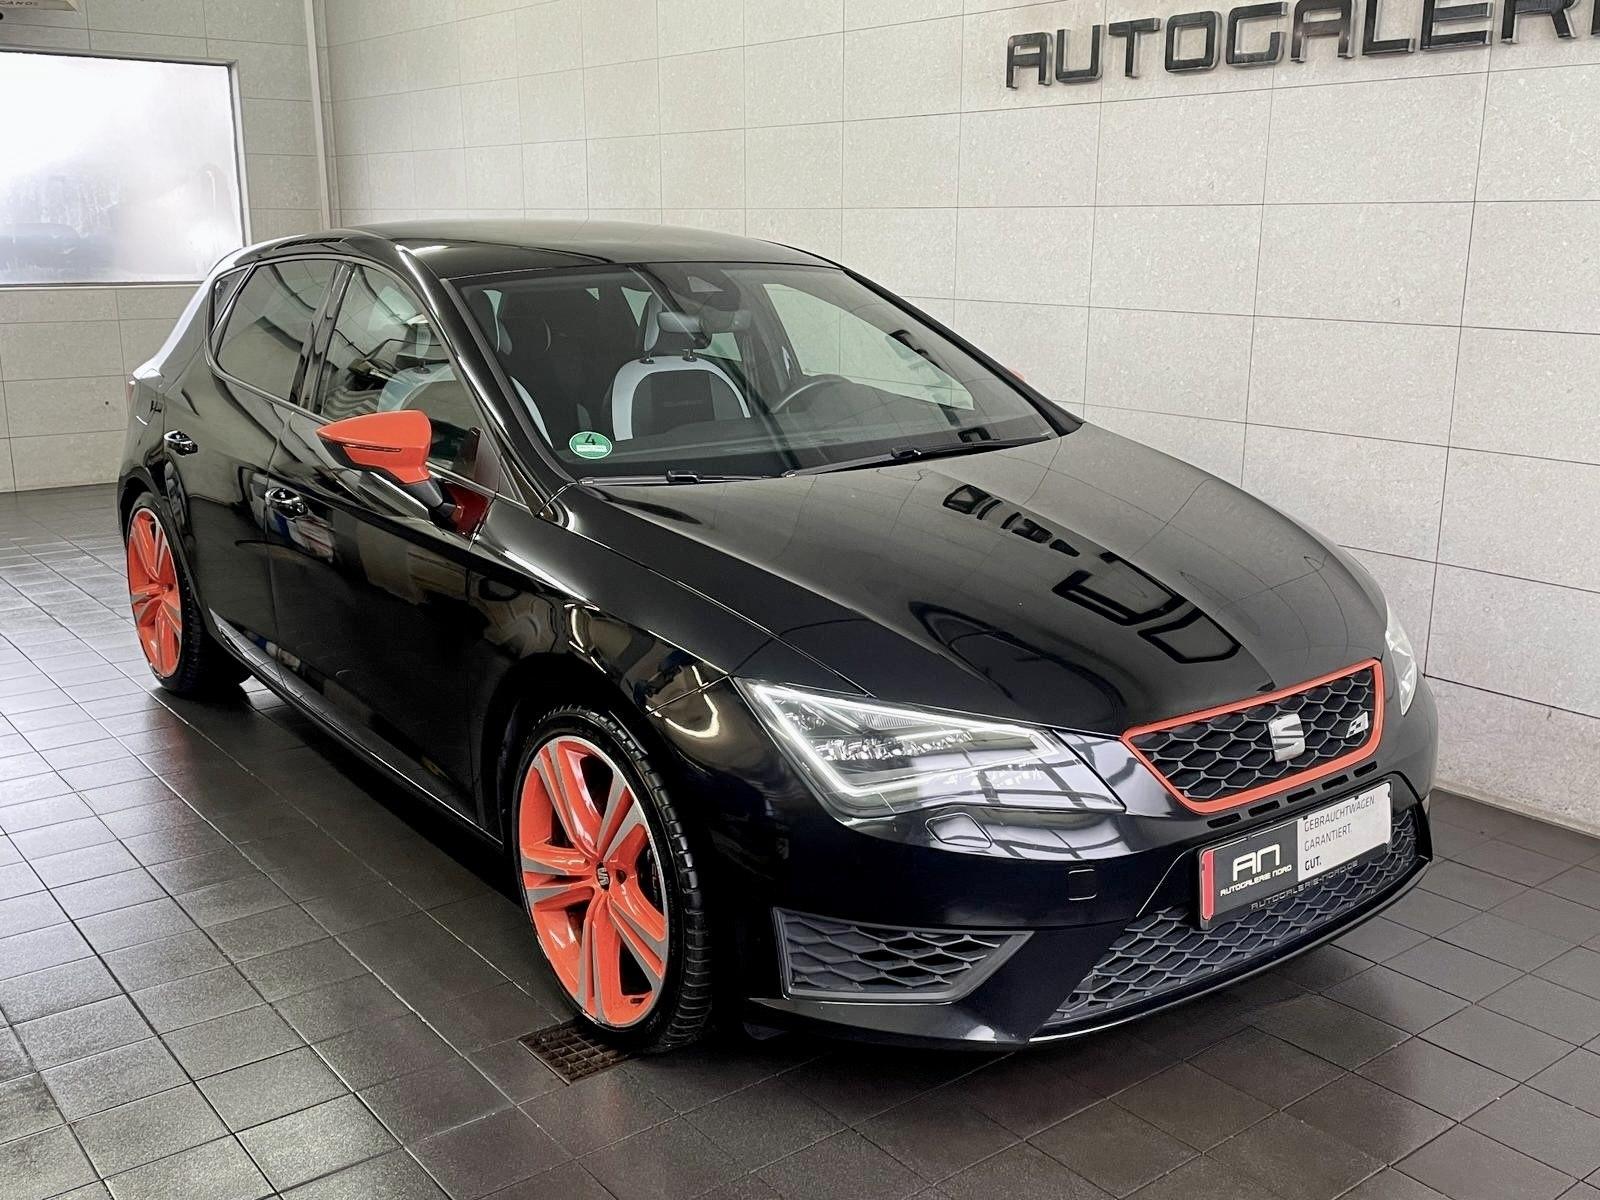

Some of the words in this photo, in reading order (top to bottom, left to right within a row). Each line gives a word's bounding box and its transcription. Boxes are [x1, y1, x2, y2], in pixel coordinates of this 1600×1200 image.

[585, 434, 596, 445] 4
[1304, 855, 1322, 871] GUT.
[1220, 872, 1271, 896] AUTOGALERIE
